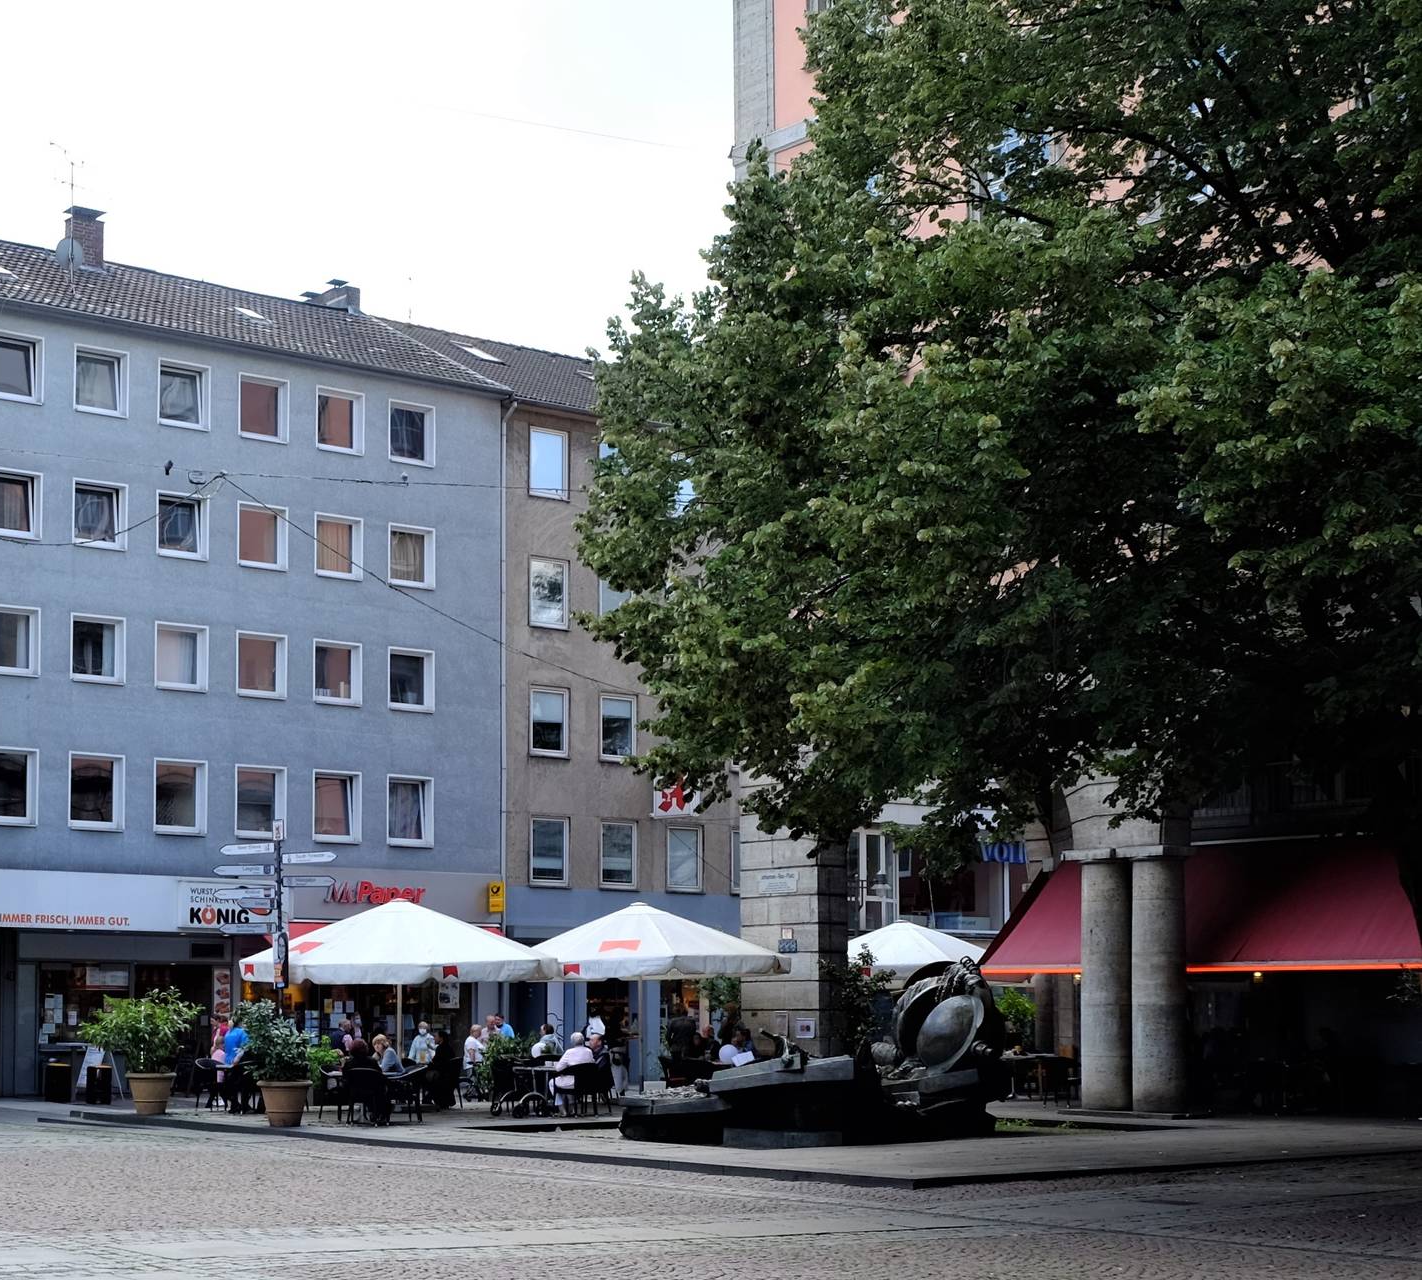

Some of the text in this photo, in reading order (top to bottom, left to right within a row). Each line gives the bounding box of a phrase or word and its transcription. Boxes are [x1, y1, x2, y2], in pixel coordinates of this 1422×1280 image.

[0, 913, 130, 927] IMMER FRISCH, IMMER GUT.
[190, 905, 250, 925] KÖNIG
